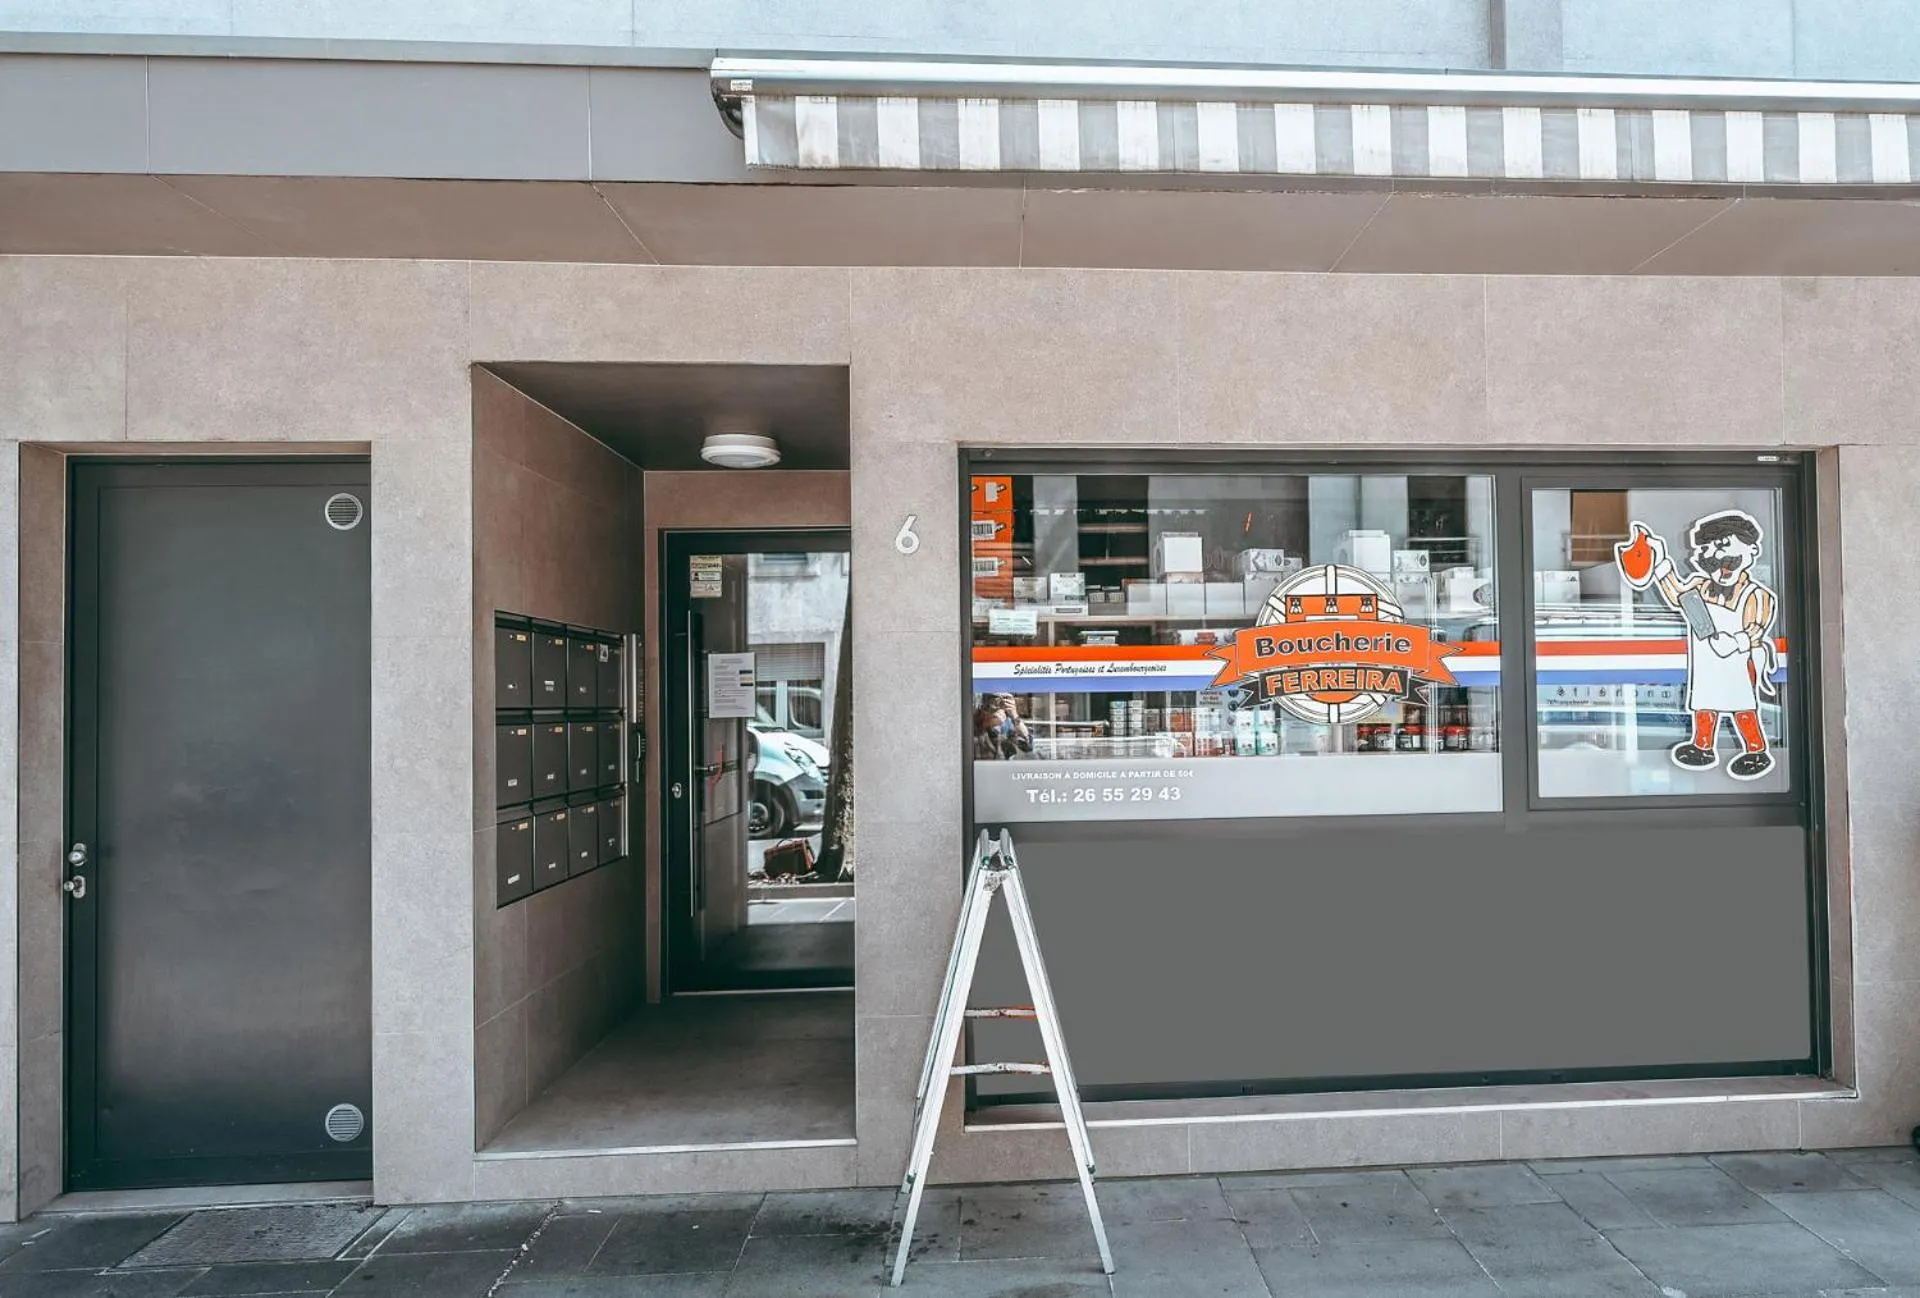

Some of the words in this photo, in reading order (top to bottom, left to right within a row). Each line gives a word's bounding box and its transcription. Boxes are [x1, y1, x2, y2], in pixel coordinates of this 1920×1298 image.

[895, 515, 920, 554] 6
[1255, 631, 1412, 658] Boucherie
[1098, 665, 1105, 673] et
[1265, 668, 1403, 697] FERREIRA
[1012, 773, 1062, 781] LIVRAISON
[1073, 771, 1117, 780] DOMICILE
[1128, 770, 1162, 779] PARTIR
[1163, 770, 1177, 779] DE
[1025, 789, 1068, 803] Tél.:
[1073, 788, 1096, 802] 26
[1102, 787, 1125, 802] 55
[1131, 787, 1153, 801] 29
[1158, 786, 1182, 801] 43
